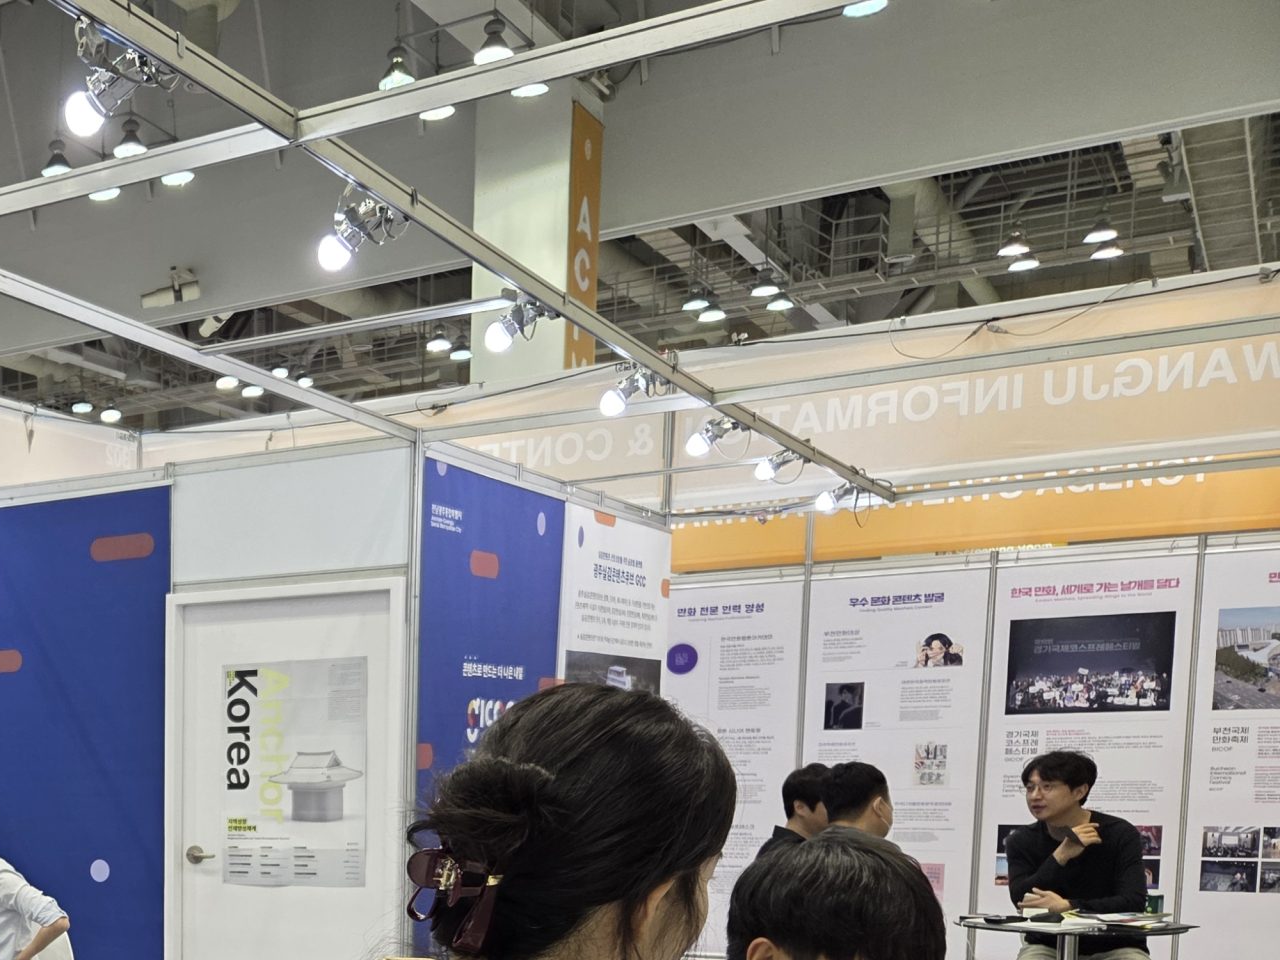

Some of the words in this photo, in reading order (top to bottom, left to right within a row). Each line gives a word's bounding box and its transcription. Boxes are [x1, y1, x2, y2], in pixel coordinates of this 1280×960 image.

[1011, 586, 1032, 598] 한국
[1034, 585, 1059, 597] 만화,
[1061, 583, 1094, 595] 세계로
[1096, 582, 1119, 593] 가는
[1120, 579, 1154, 591] 날개를
[849, 597, 869, 608] 우수
[892, 594, 922, 606] 콘텐츠
[924, 592, 945, 603] 발굴
[677, 607, 696, 618] 만화
[700, 606, 719, 616] 전문
[722, 604, 741, 615] 인력
[745, 602, 765, 613] 양성
[226, 669, 258, 791] Korea
[1005, 730, 1039, 739] 경기국제
[259, 668, 290, 825] Anchor
